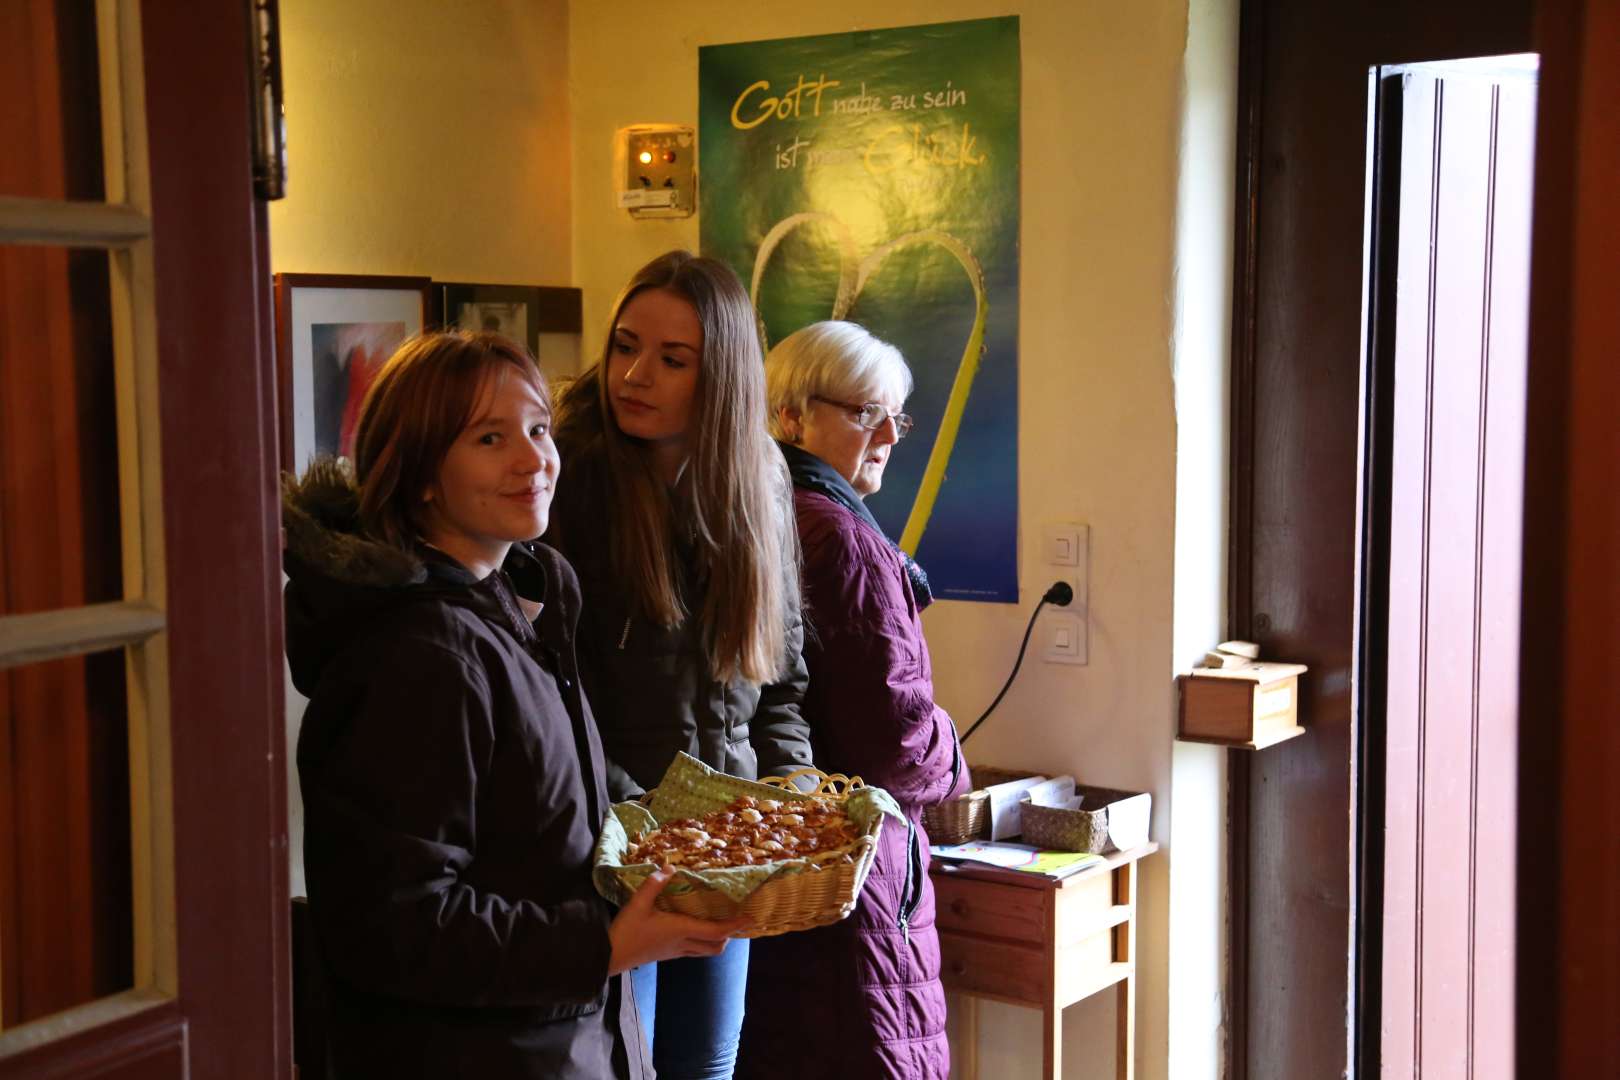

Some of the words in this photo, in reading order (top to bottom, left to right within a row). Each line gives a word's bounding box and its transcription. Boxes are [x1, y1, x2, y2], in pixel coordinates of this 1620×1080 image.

[731, 74, 840, 130] Gott
[890, 94, 916, 111] zu
[923, 81, 966, 109] sein
[775, 136, 810, 169] ist
